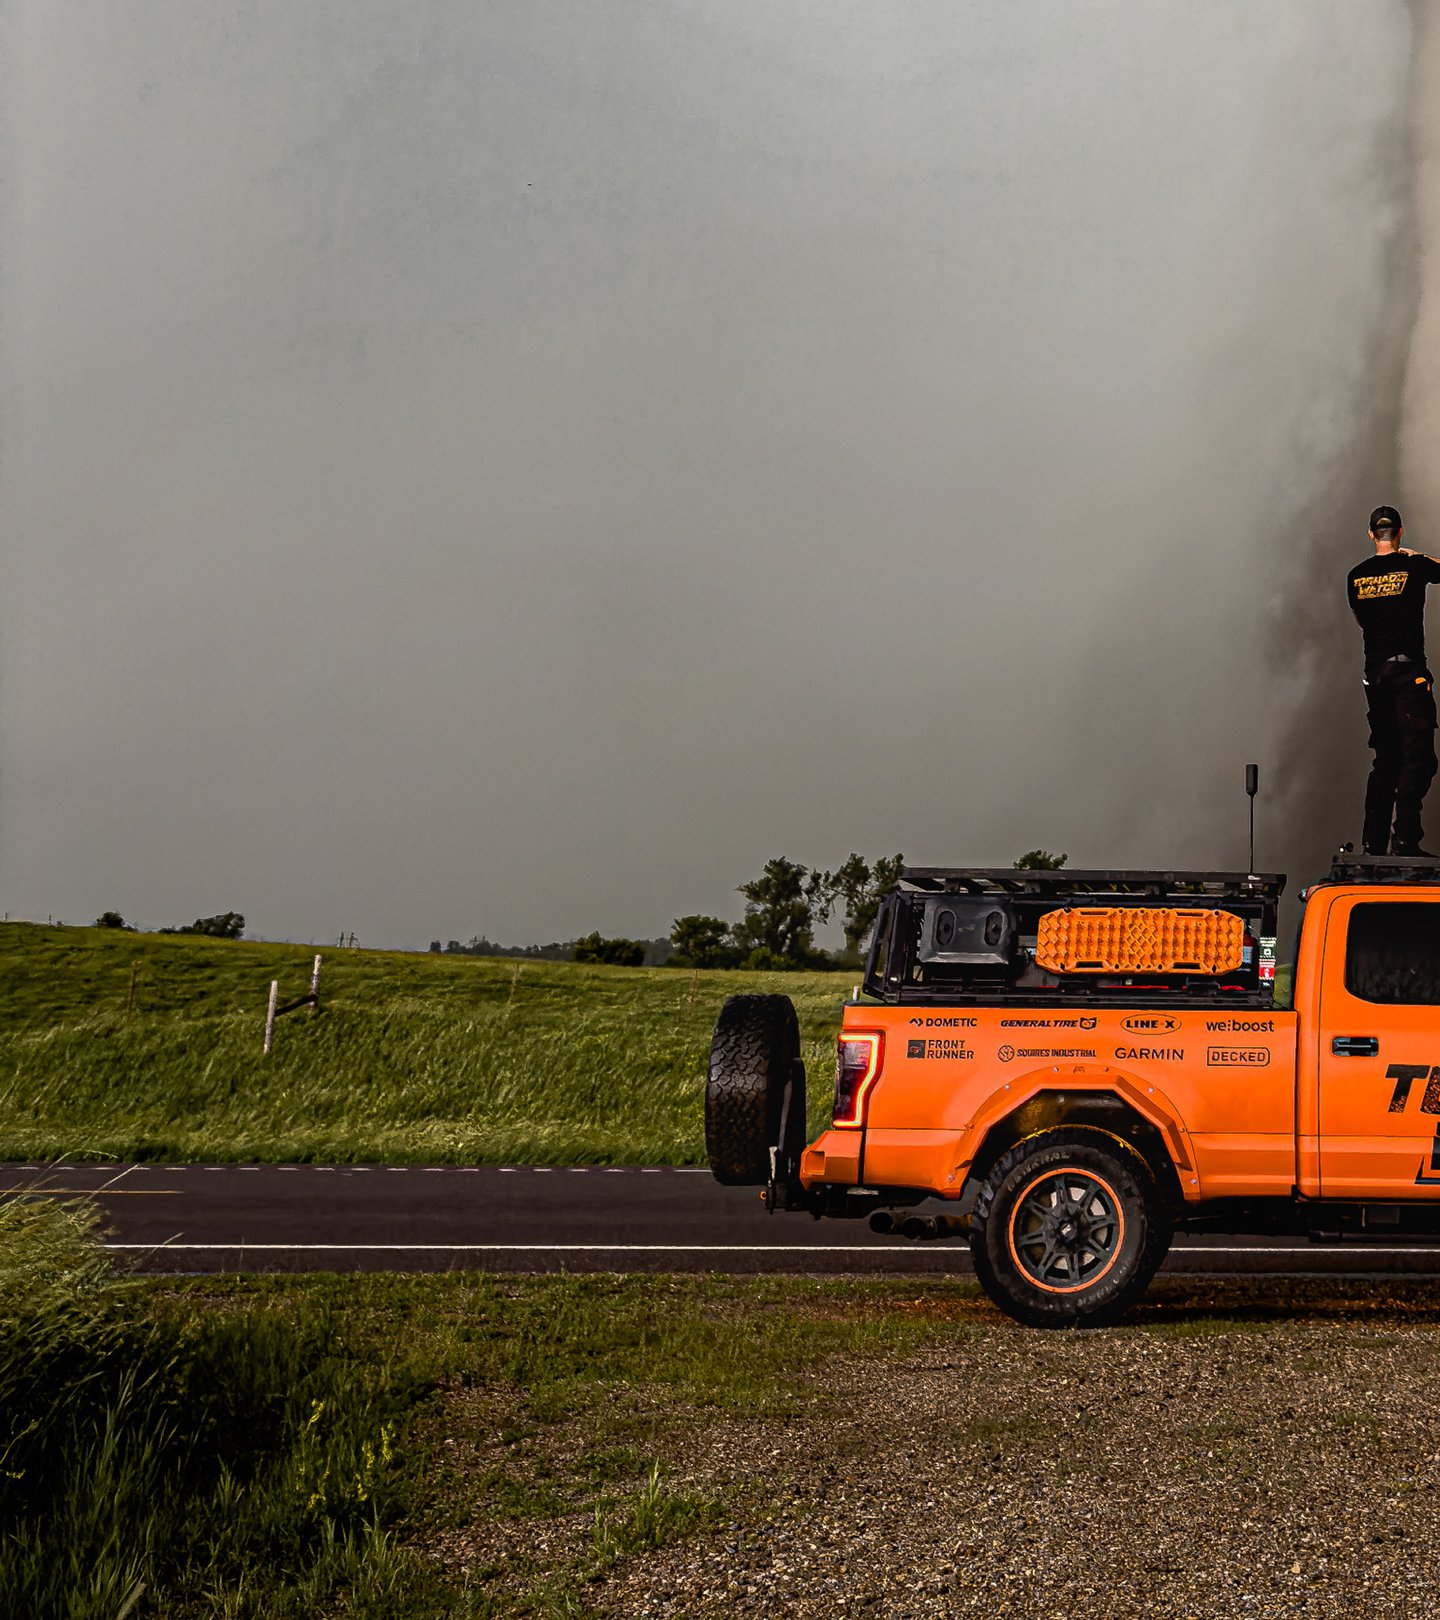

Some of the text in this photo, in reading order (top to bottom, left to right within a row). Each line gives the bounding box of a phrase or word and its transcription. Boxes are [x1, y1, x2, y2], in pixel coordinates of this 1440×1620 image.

[1359, 583, 1400, 595] WATCH
[925, 1018, 978, 1027] DOMETIC
[1000, 1019, 1078, 1028] GENERAL TIRE
[928, 1039, 966, 1049] FRONT
[926, 1050, 975, 1059] RUNNER
[1051, 1049, 1097, 1057] INDUSTRIAL
[1114, 1047, 1185, 1060] GARMIN
[1211, 1051, 1266, 1062] DECKED
